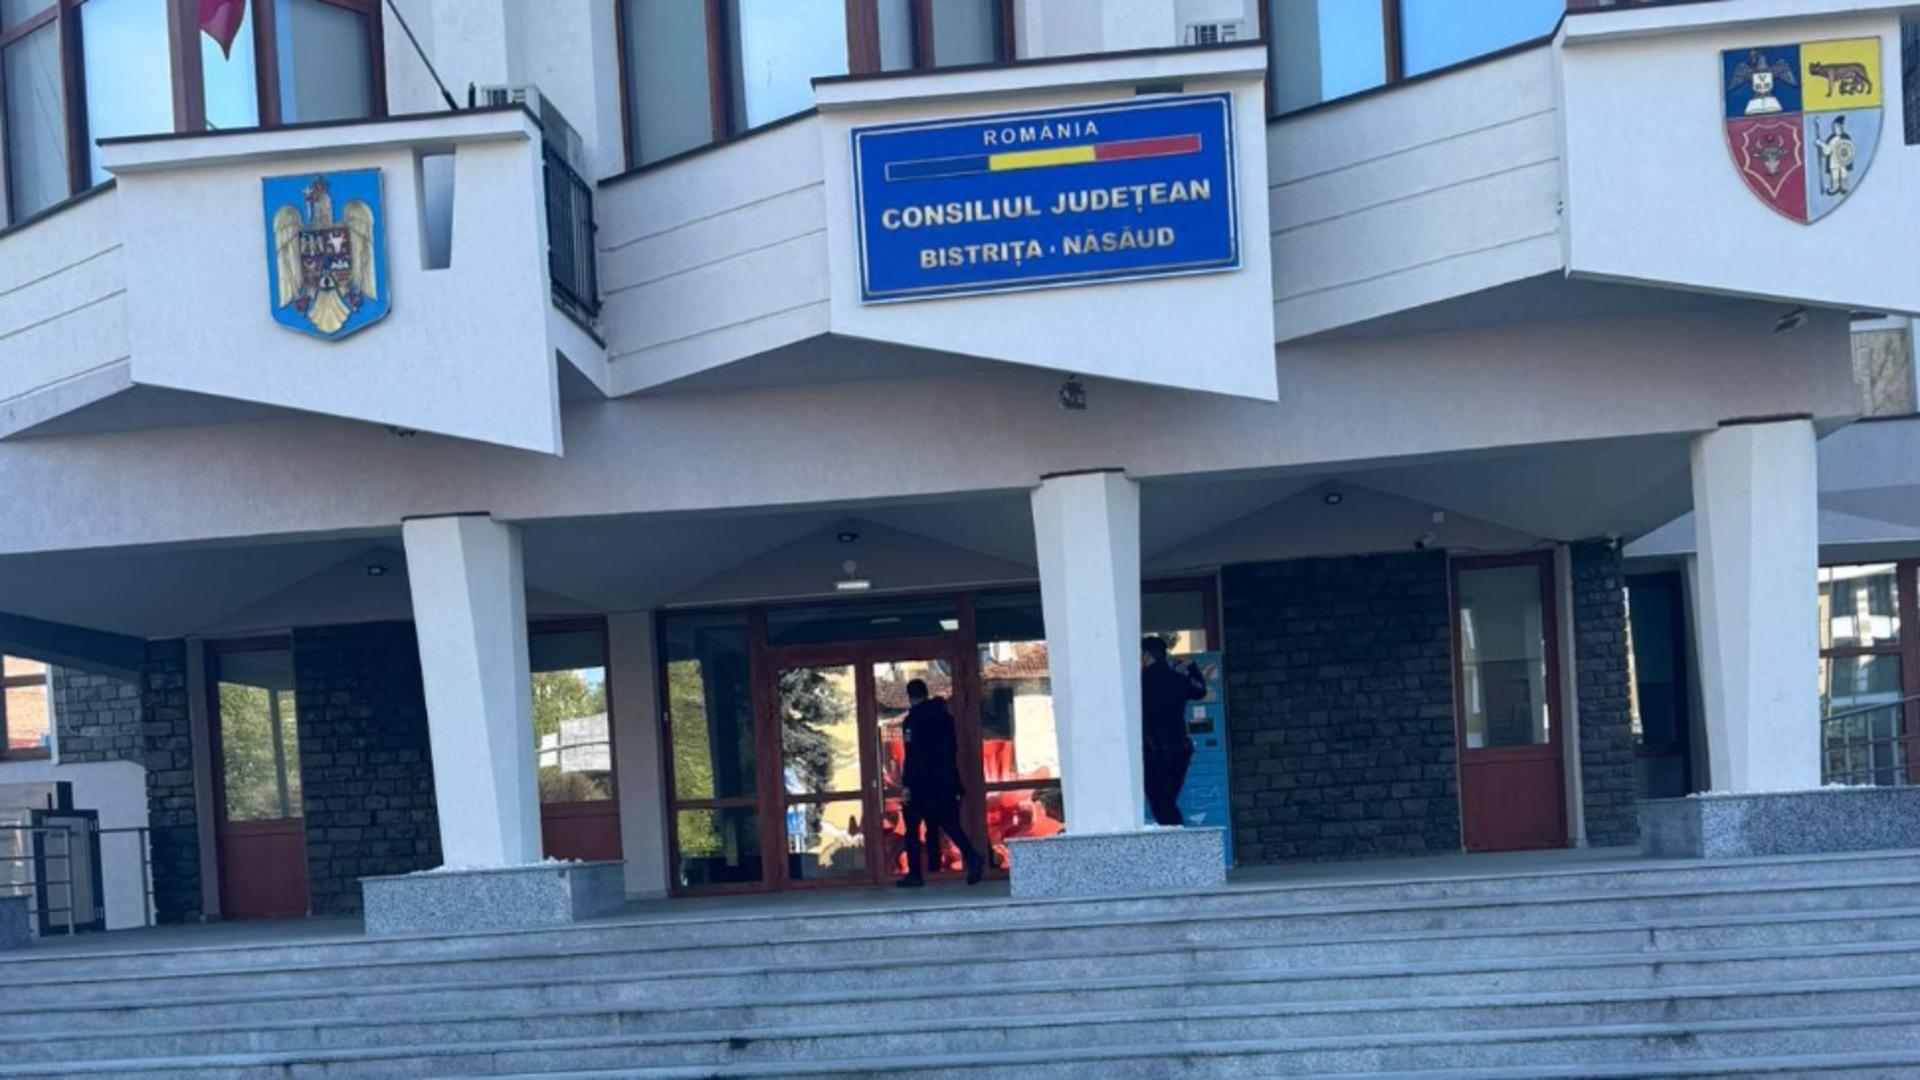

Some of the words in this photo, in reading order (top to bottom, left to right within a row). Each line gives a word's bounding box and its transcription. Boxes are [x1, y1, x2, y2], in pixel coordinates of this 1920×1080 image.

[983, 120, 1099, 146] ROMÂNIA
[882, 195, 1041, 230] CONSILIUL
[1051, 178, 1211, 213] JUDEȚEAN
[920, 238, 1042, 267] BISTRIȚA
[1063, 226, 1175, 255] NĂSĂUD
